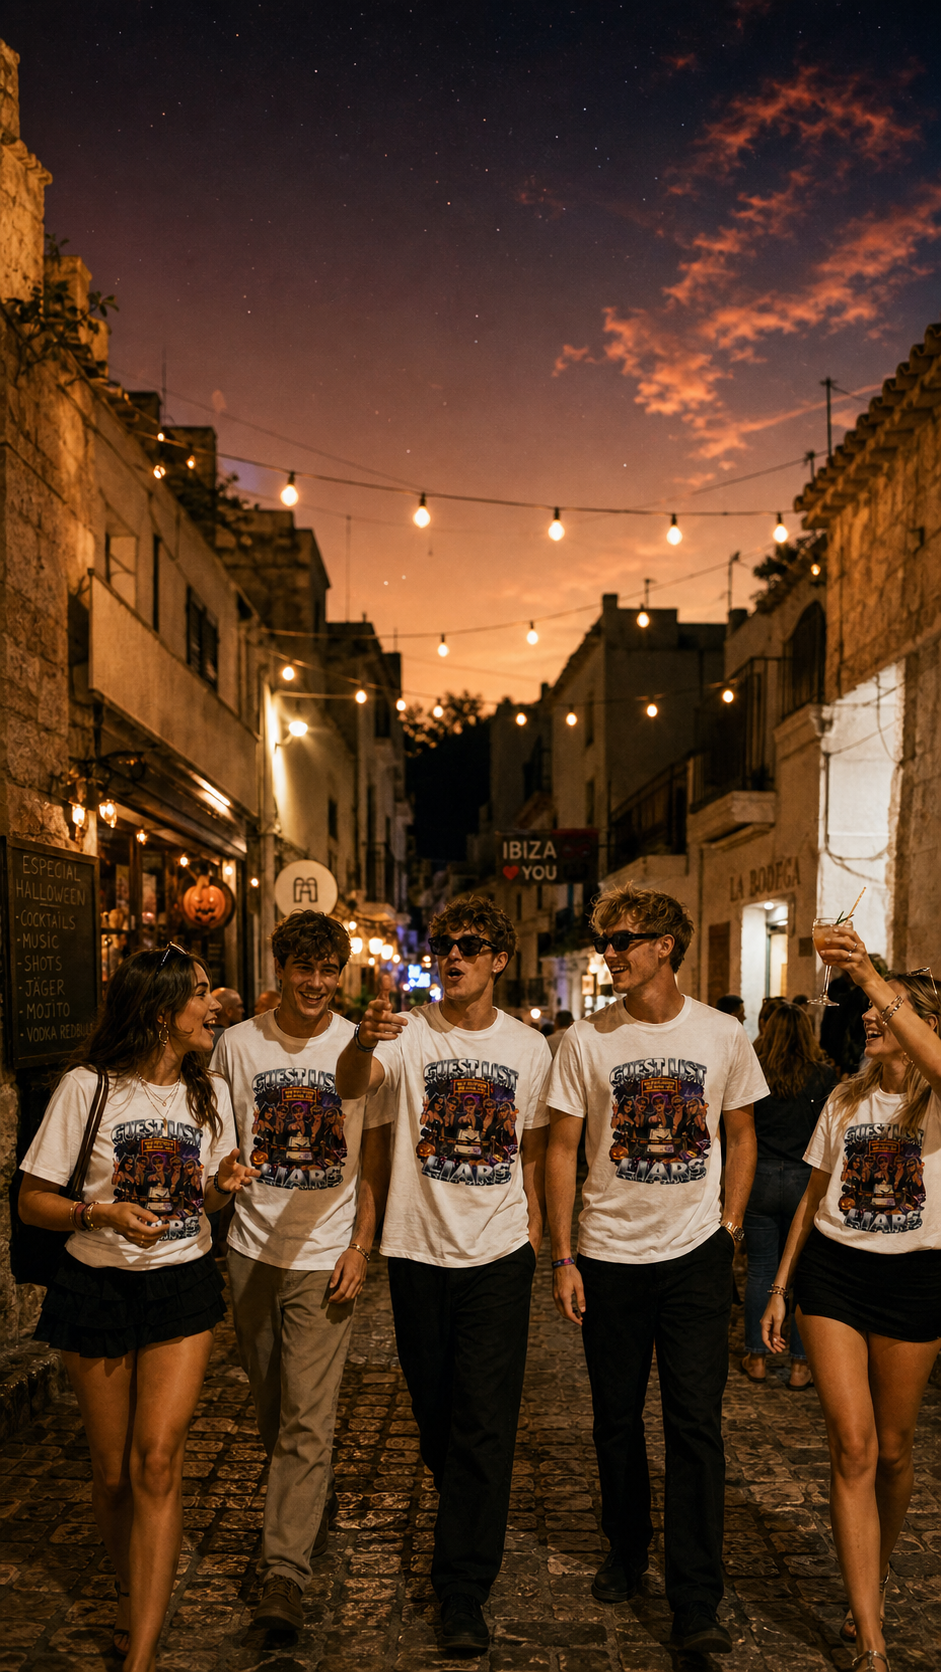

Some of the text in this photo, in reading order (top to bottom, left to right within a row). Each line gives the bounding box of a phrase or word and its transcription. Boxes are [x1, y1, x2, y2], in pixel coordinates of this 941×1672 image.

[503, 841, 557, 859] IBIZA
[22, 855, 81, 882] ESPECIAL
[522, 865, 557, 880] YOU
[730, 856, 801, 902] LA BODEGA
[15, 878, 86, 906] HALLOWEEN
[20, 909, 76, 930] COCKTAILS
[22, 931, 60, 949] MUSIC
[24, 954, 63, 972] SHOTS
[25, 976, 66, 997] JÄGER
[26, 1025, 58, 1043] VODKA
[251, 1068, 307, 1094] GUEST
[308, 1069, 337, 1095] LIS
[423, 1058, 480, 1086] GUEST
[482, 1061, 519, 1091] LIST
[608, 1058, 665, 1087] GUEST
[667, 1058, 708, 1087] LIST
[111, 1119, 167, 1145] GUEST
[844, 1123, 892, 1145] GUEST
[257, 1163, 344, 1190] LIARS
[421, 1155, 512, 1186] LIARS
[616, 1158, 707, 1185] LIARS
[844, 1208, 923, 1234] LIARS
